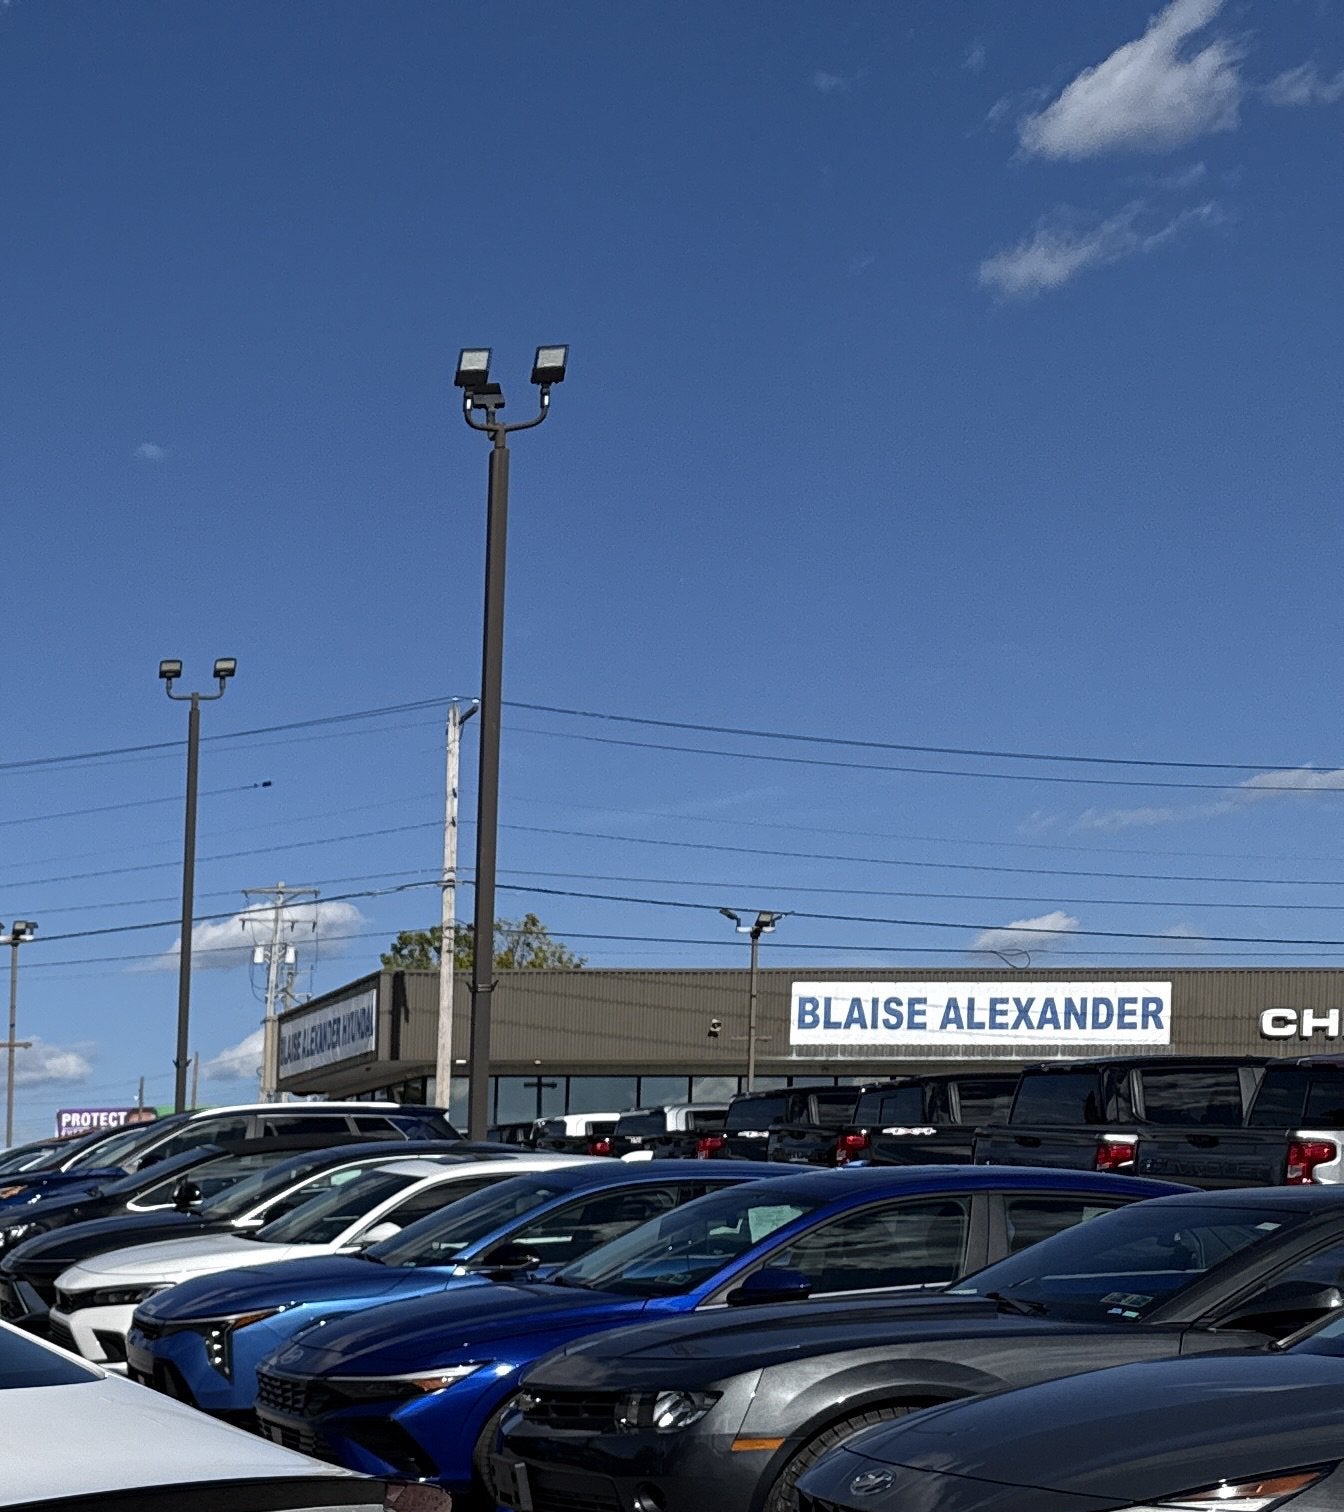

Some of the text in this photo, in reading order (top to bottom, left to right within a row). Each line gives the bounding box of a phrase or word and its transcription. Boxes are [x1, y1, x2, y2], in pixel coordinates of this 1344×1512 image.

[796, 995, 1164, 1031] BLAISE ALEXANDER
[1260, 1008, 1344, 1038] CH
[302, 1016, 341, 1059] ALEXANDER
[61, 1111, 127, 1127] PROTECT
